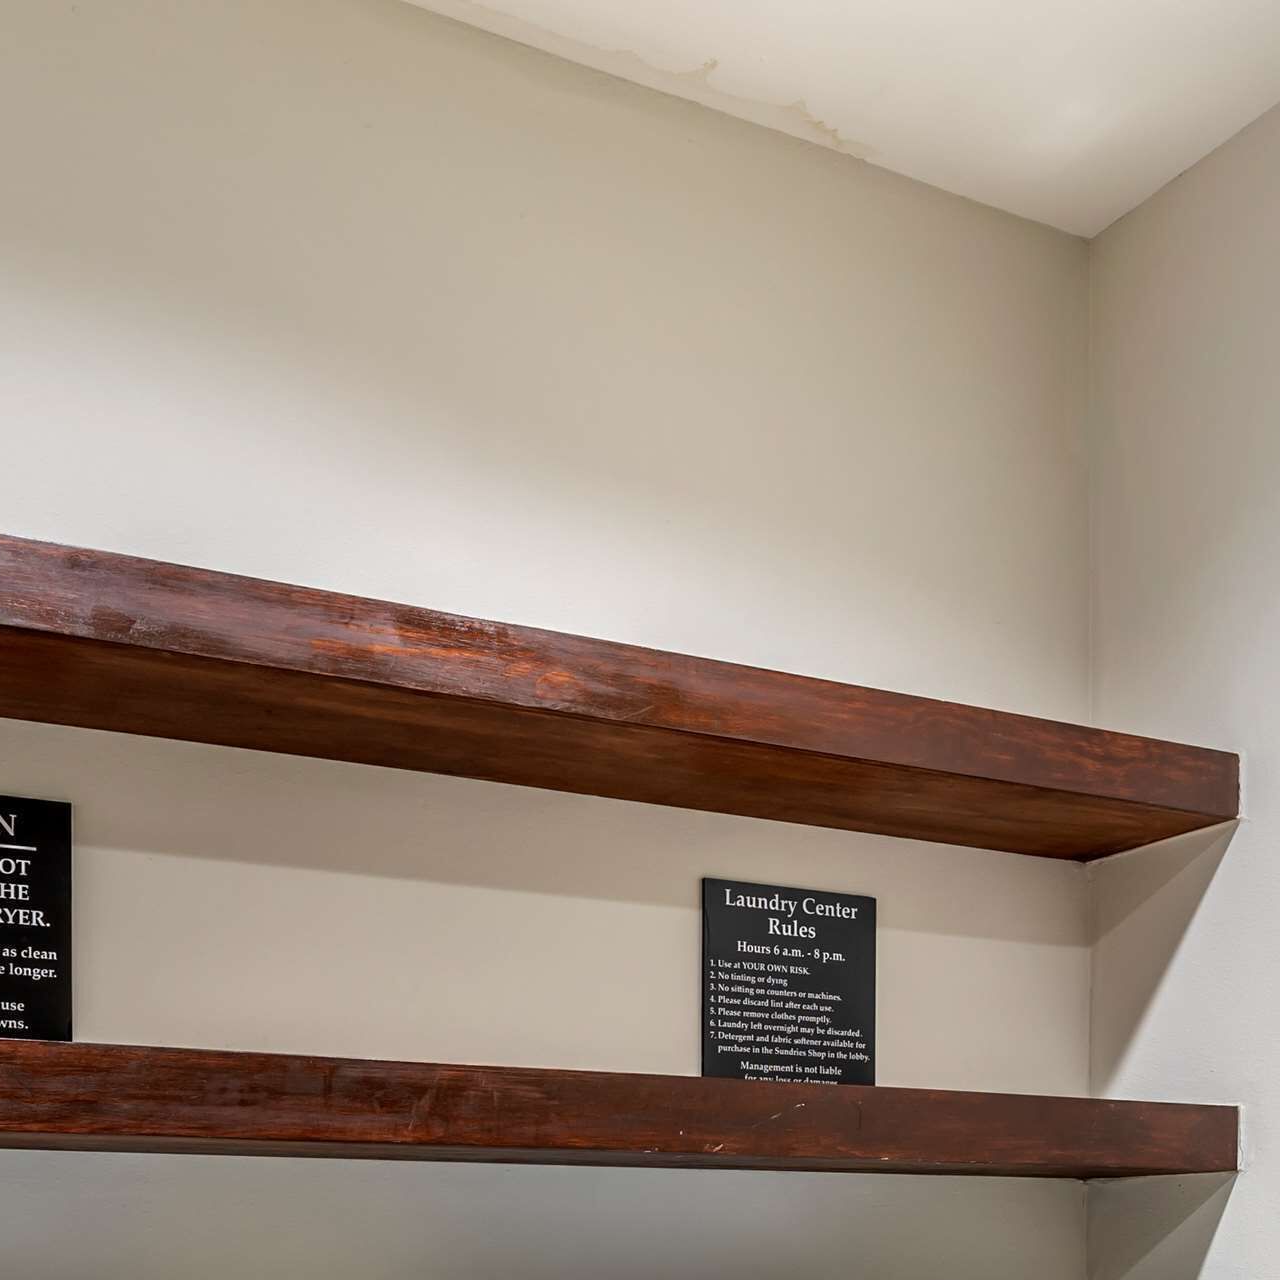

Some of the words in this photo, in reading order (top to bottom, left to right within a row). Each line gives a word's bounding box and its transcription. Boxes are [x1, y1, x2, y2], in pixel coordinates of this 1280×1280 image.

[725, 888, 798, 918] Laundry
[802, 897, 858, 919] Center
[768, 917, 817, 939] Rules
[2, 947, 17, 958] as
[20, 946, 58, 961] clean
[737, 941, 771, 955] Hours
[773, 944, 780, 956] 6
[782, 948, 805, 958] a.m.
[813, 948, 820, 958] 8
[822, 951, 846, 964] p.m.
[9, 963, 57, 980] longer.
[718, 960, 732, 968] Use
[742, 962, 766, 971] YOUR
[767, 964, 788, 973] OWN
[718, 972, 730, 980] No
[730, 973, 756, 984] tinting
[766, 976, 788, 987] dying
[718, 984, 730, 992] No
[730, 985, 755, 996] sitting
[756, 987, 765, 995] on
[766, 988, 797, 998] counters
[718, 995, 741, 1004] Please
[742, 997, 769, 1007] discard
[770, 999, 784, 1008] lint
[784, 1001, 800, 1010] after
[802, 1002, 819, 1011] each
[820, 1004, 834, 1013] use.
[718, 1007, 741, 1016] Please
[743, 1010, 769, 1019] remove
[770, 1012, 796, 1021] clothes
[797, 1014, 832, 1025] promptly.
[718, 1019, 749, 1030] Laundry
[750, 1021, 763, 1030] left
[763, 1024, 799, 1035] overnight
[800, 1026, 815, 1035] may
[817, 1026, 826, 1035] be
[827, 1027, 863, 1038] discarded.
[718, 1032, 755, 1043] Detergent
[756, 1034, 770, 1042] and
[771, 1034, 792, 1044] fabric
[823, 1037, 854, 1049] available
[855, 1040, 866, 1049] for
[717, 1044, 751, 1054] purchase
[752, 1046, 760, 1054] in
[761, 1046, 773, 1054] the
[774, 1047, 807, 1057] Sundries
[807, 1049, 827, 1060] Shop
[827, 1050, 836, 1058] in
[837, 1050, 848, 1060] the
[849, 1051, 871, 1063] lobby.
[740, 1061, 794, 1073] Management
[795, 1064, 803, 1073] is
[804, 1066, 818, 1074] not
[819, 1065, 842, 1076] liable
